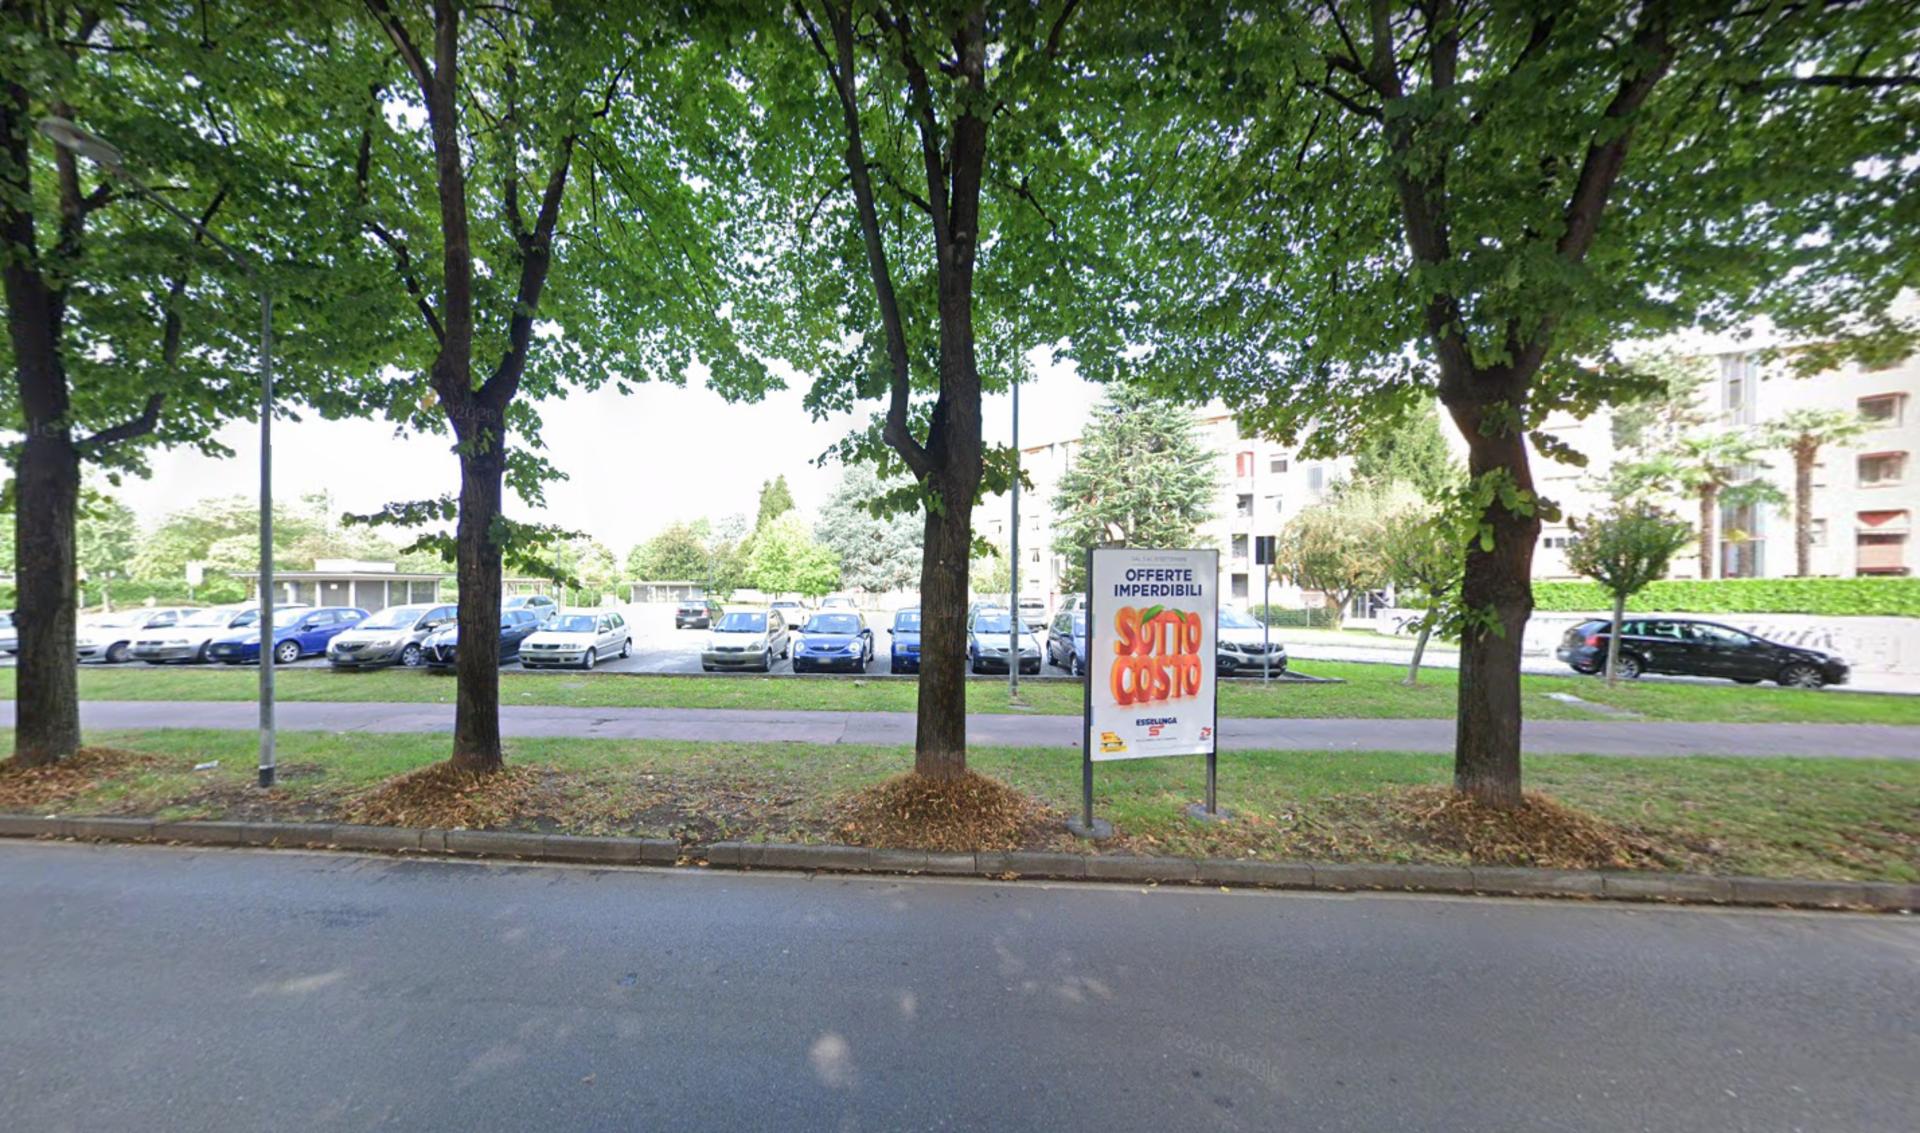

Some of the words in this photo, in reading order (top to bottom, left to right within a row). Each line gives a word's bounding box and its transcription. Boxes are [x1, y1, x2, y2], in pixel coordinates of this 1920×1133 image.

[1125, 568, 1192, 581] OFFERTE
[1114, 584, 1202, 597] IMPERDIBILI
[1114, 606, 1202, 656] SOTTO
[1110, 655, 1202, 705] COSTO
[1136, 717, 1177, 726] ESSELUNGA
